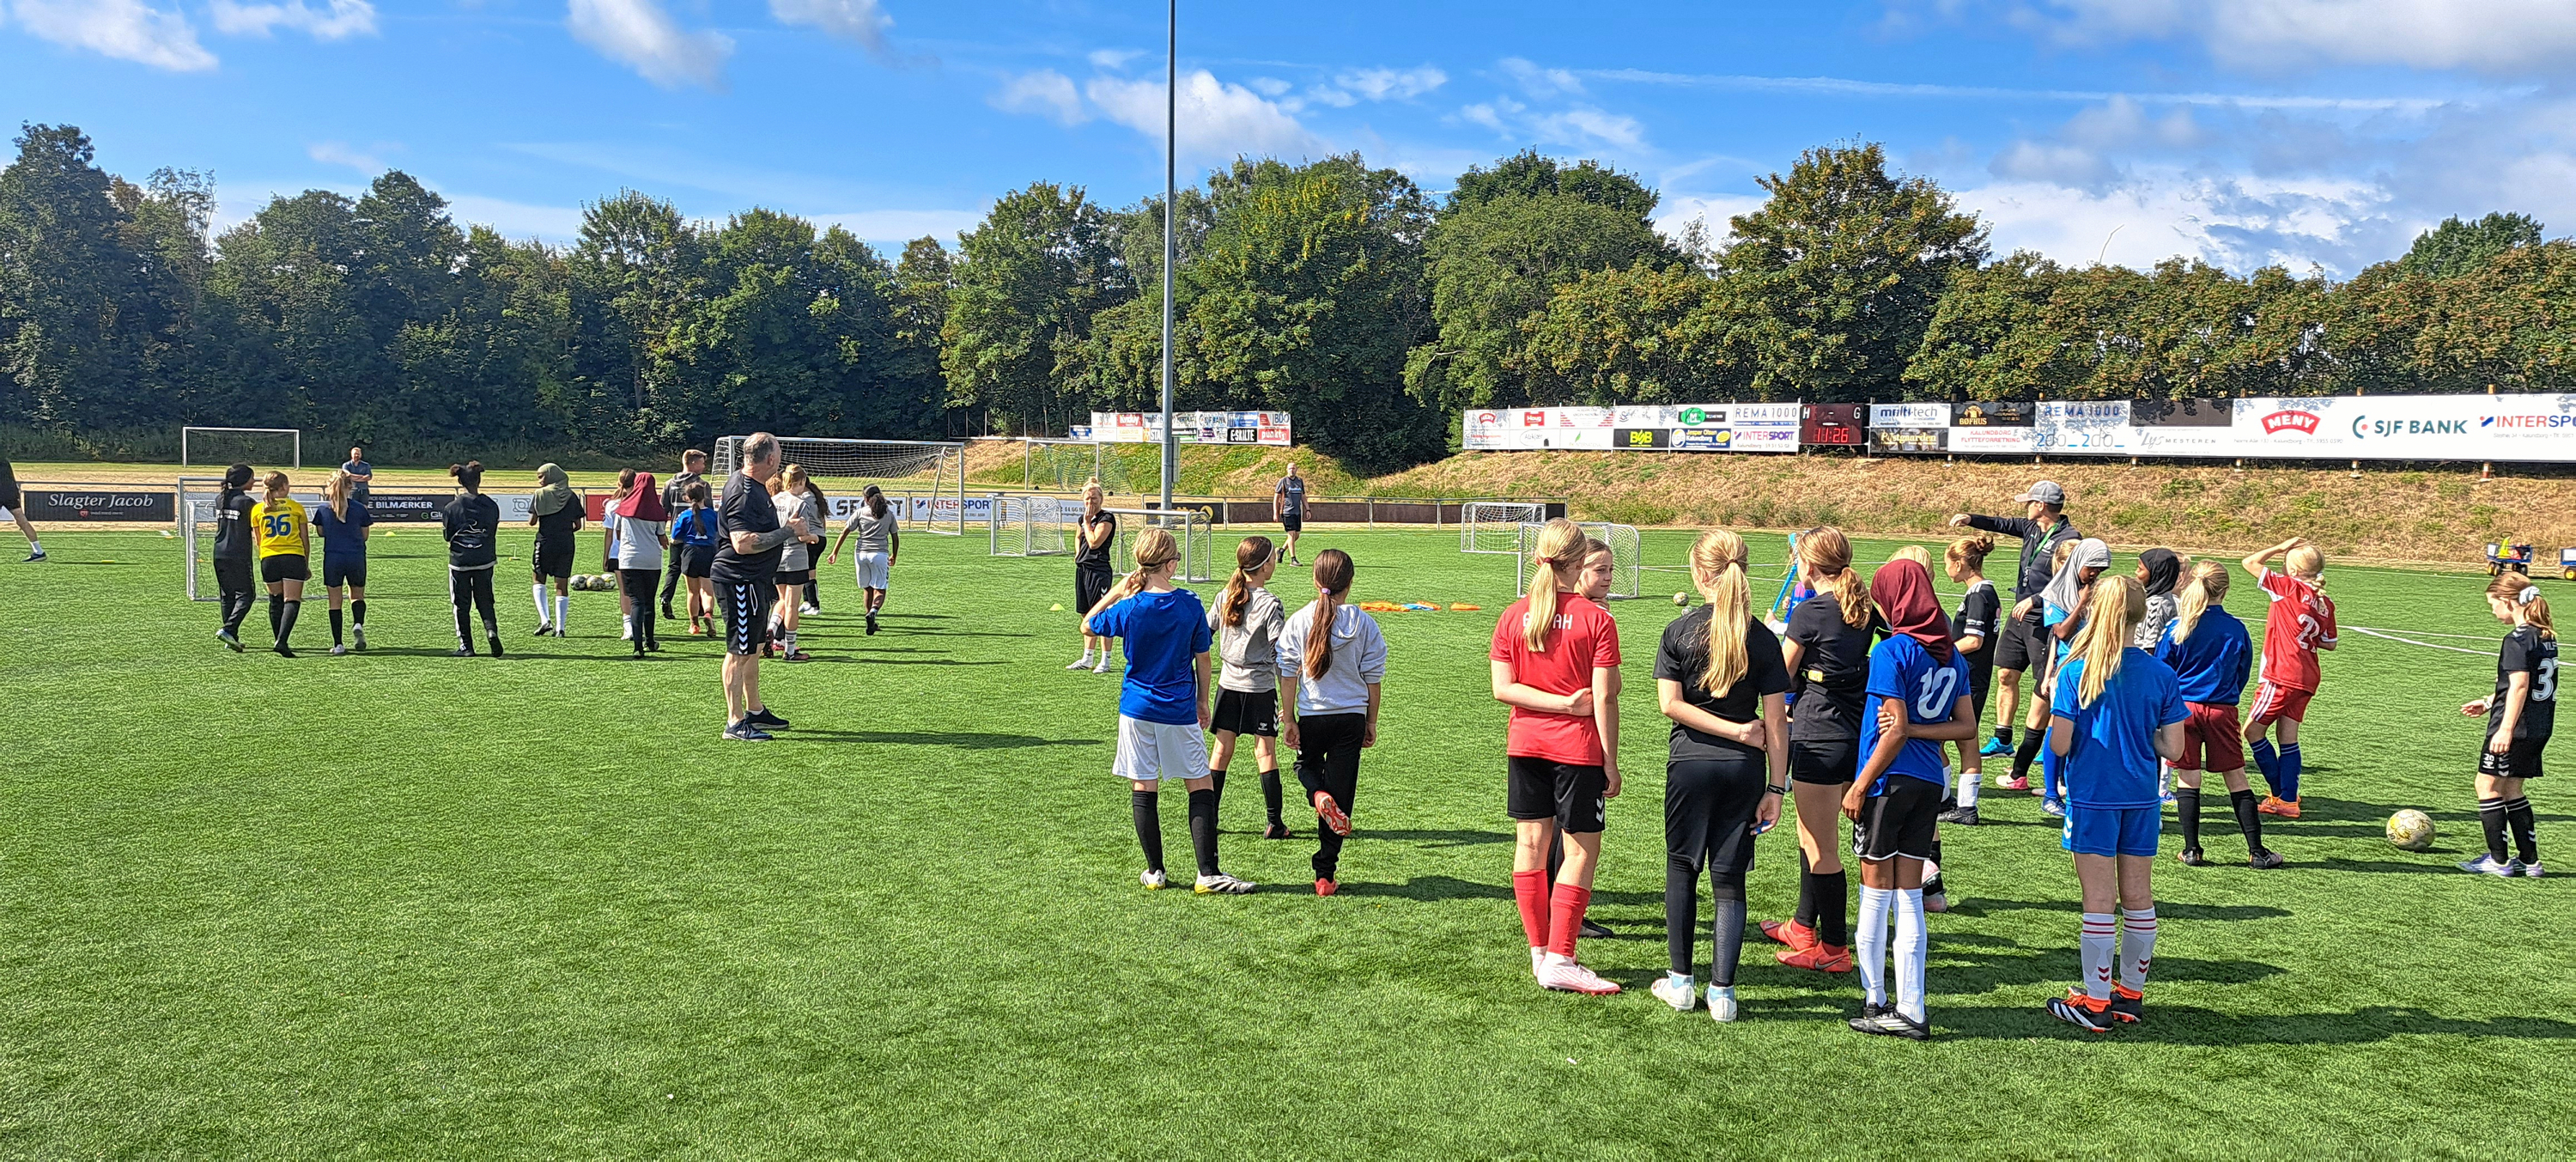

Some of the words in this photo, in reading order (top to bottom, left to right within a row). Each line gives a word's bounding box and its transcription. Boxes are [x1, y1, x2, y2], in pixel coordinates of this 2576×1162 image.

[1735, 407, 1767, 417] REMA
[1771, 407, 1797, 417] 1000
[1802, 407, 1811, 419] H
[1853, 406, 1862, 419] G
[2044, 405, 2084, 417] REMA
[2089, 405, 2120, 417] 1000
[2268, 414, 2316, 429] MENY
[2374, 420, 2403, 437] SJF
[2409, 420, 2468, 434] BANK
[1743, 431, 1795, 440] INTERSPORT
[1817, 428, 1850, 443] 11:26
[48, 493, 106, 509] Slagter
[107, 494, 154, 508] Jacob
[263, 514, 291, 538] 36
[1917, 666, 1957, 720] 10
